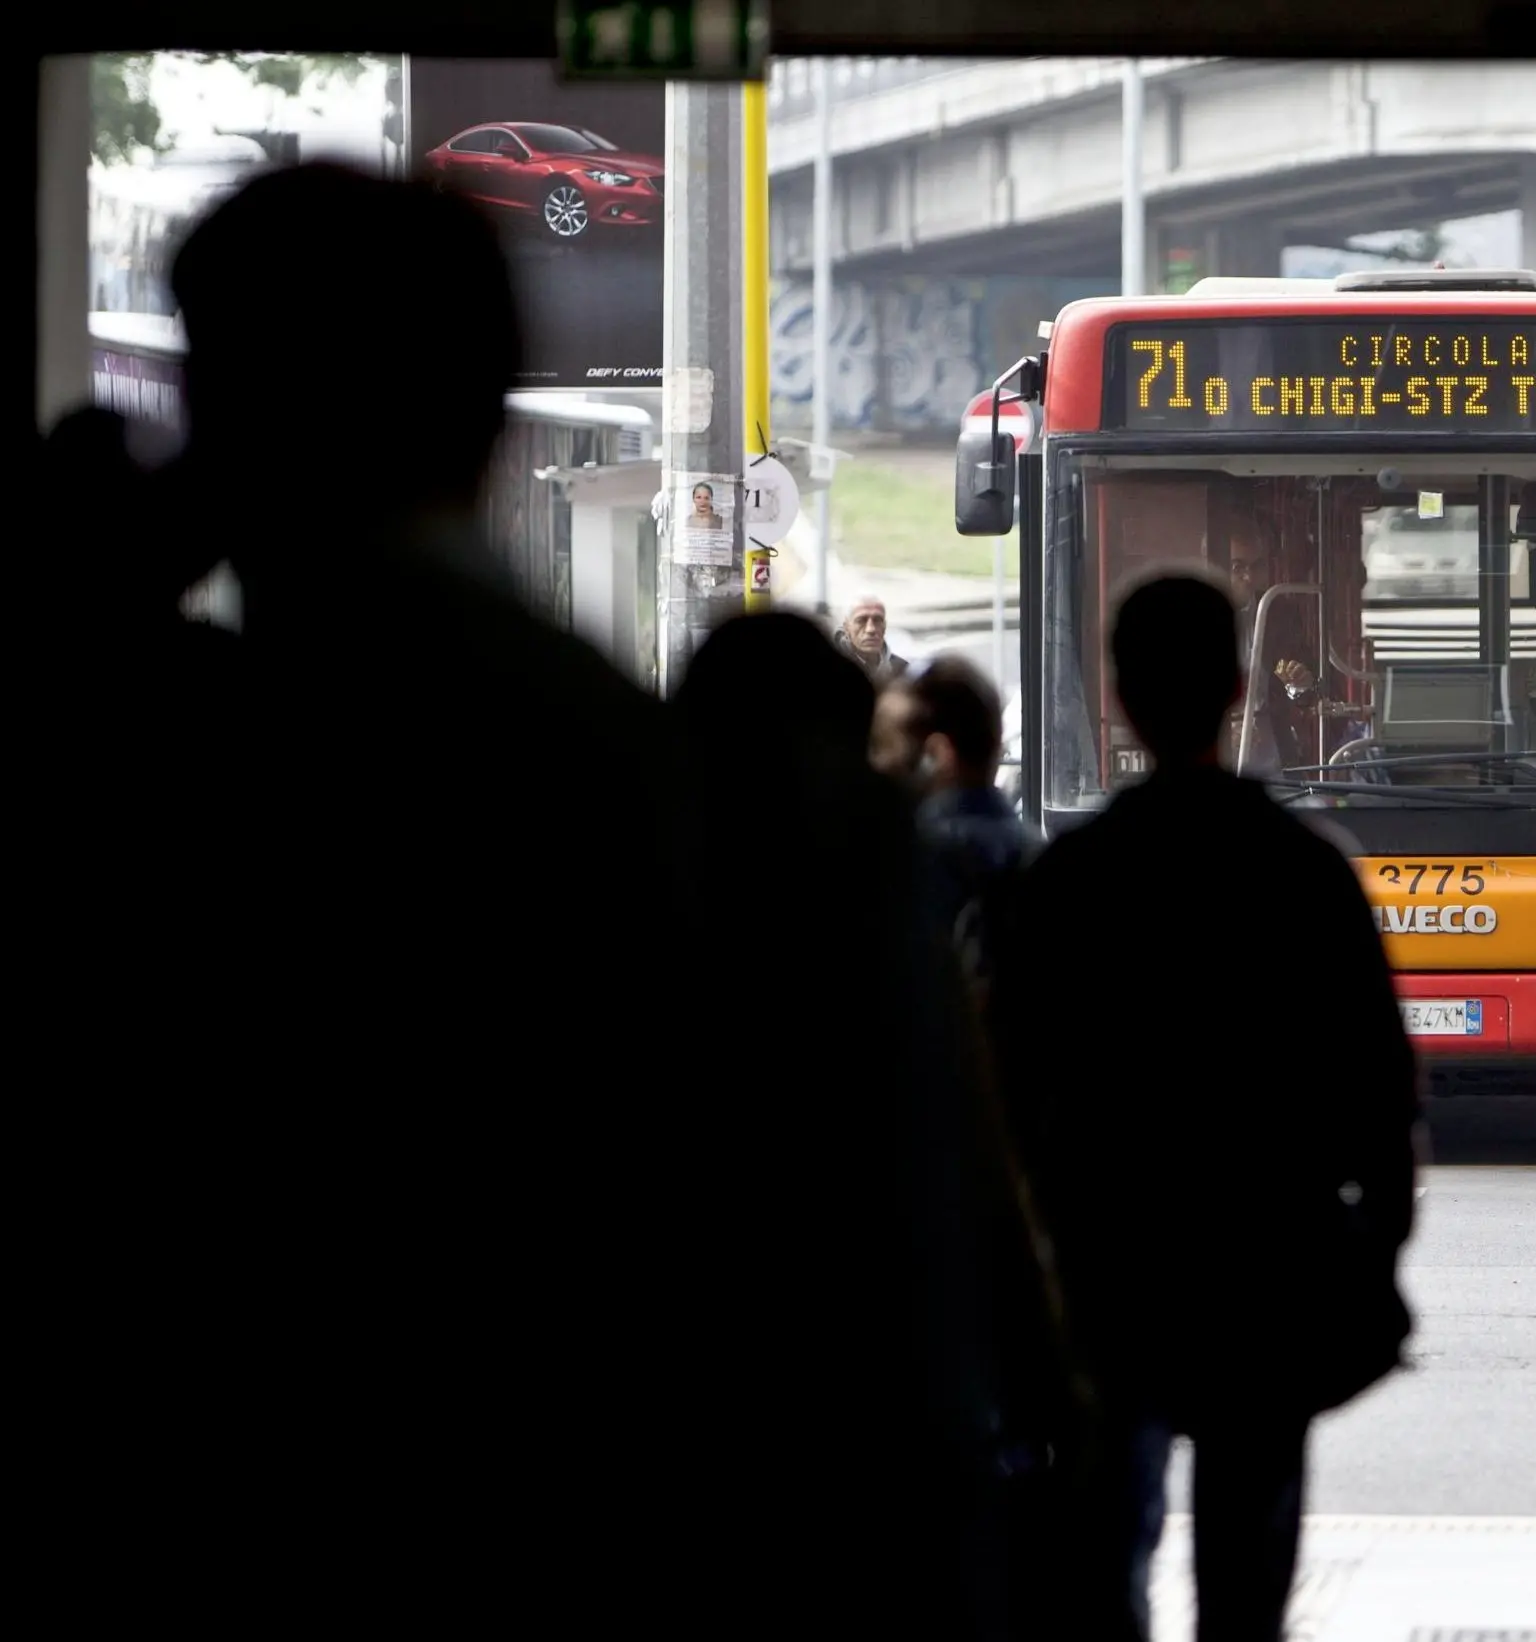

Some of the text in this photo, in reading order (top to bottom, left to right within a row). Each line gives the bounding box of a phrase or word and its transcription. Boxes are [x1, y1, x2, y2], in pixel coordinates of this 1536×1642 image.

[586, 367, 622, 377] DEFY
[1132, 341, 1192, 407] 71
[1252, 376, 1488, 415] CHIGI-STZ
[1373, 905, 1497, 933] IVECO
